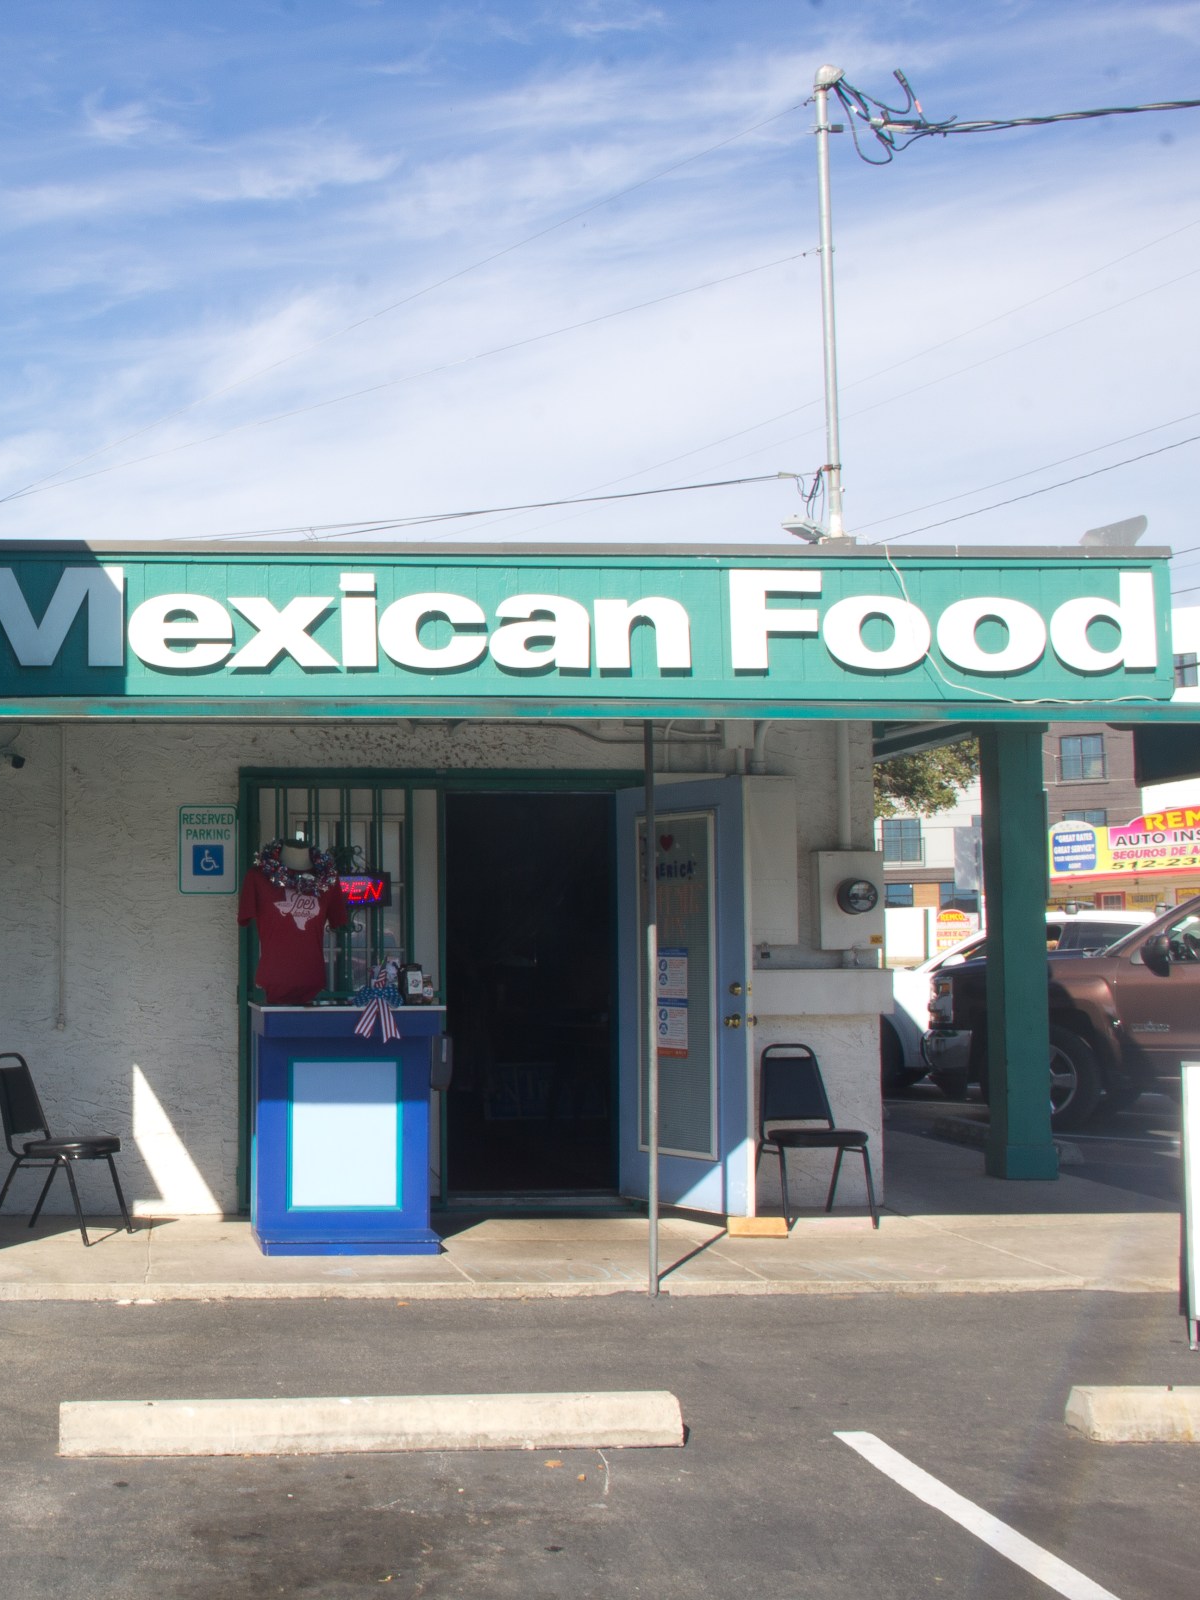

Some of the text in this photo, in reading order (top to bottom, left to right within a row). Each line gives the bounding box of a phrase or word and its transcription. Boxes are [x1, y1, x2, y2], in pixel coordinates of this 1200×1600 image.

[729, 569, 1158, 672] Food
[182, 812, 234, 826] RESERVED
[186, 828, 231, 841] PARKING
[1116, 833, 1166, 847] AUTO
[1112, 848, 1166, 861] SEGUROS
[1170, 845, 1187, 857] DE
[1112, 857, 1200, 871] 512-23
[339, 881, 383, 900] PEN
[939, 912, 964, 922] REMCO
